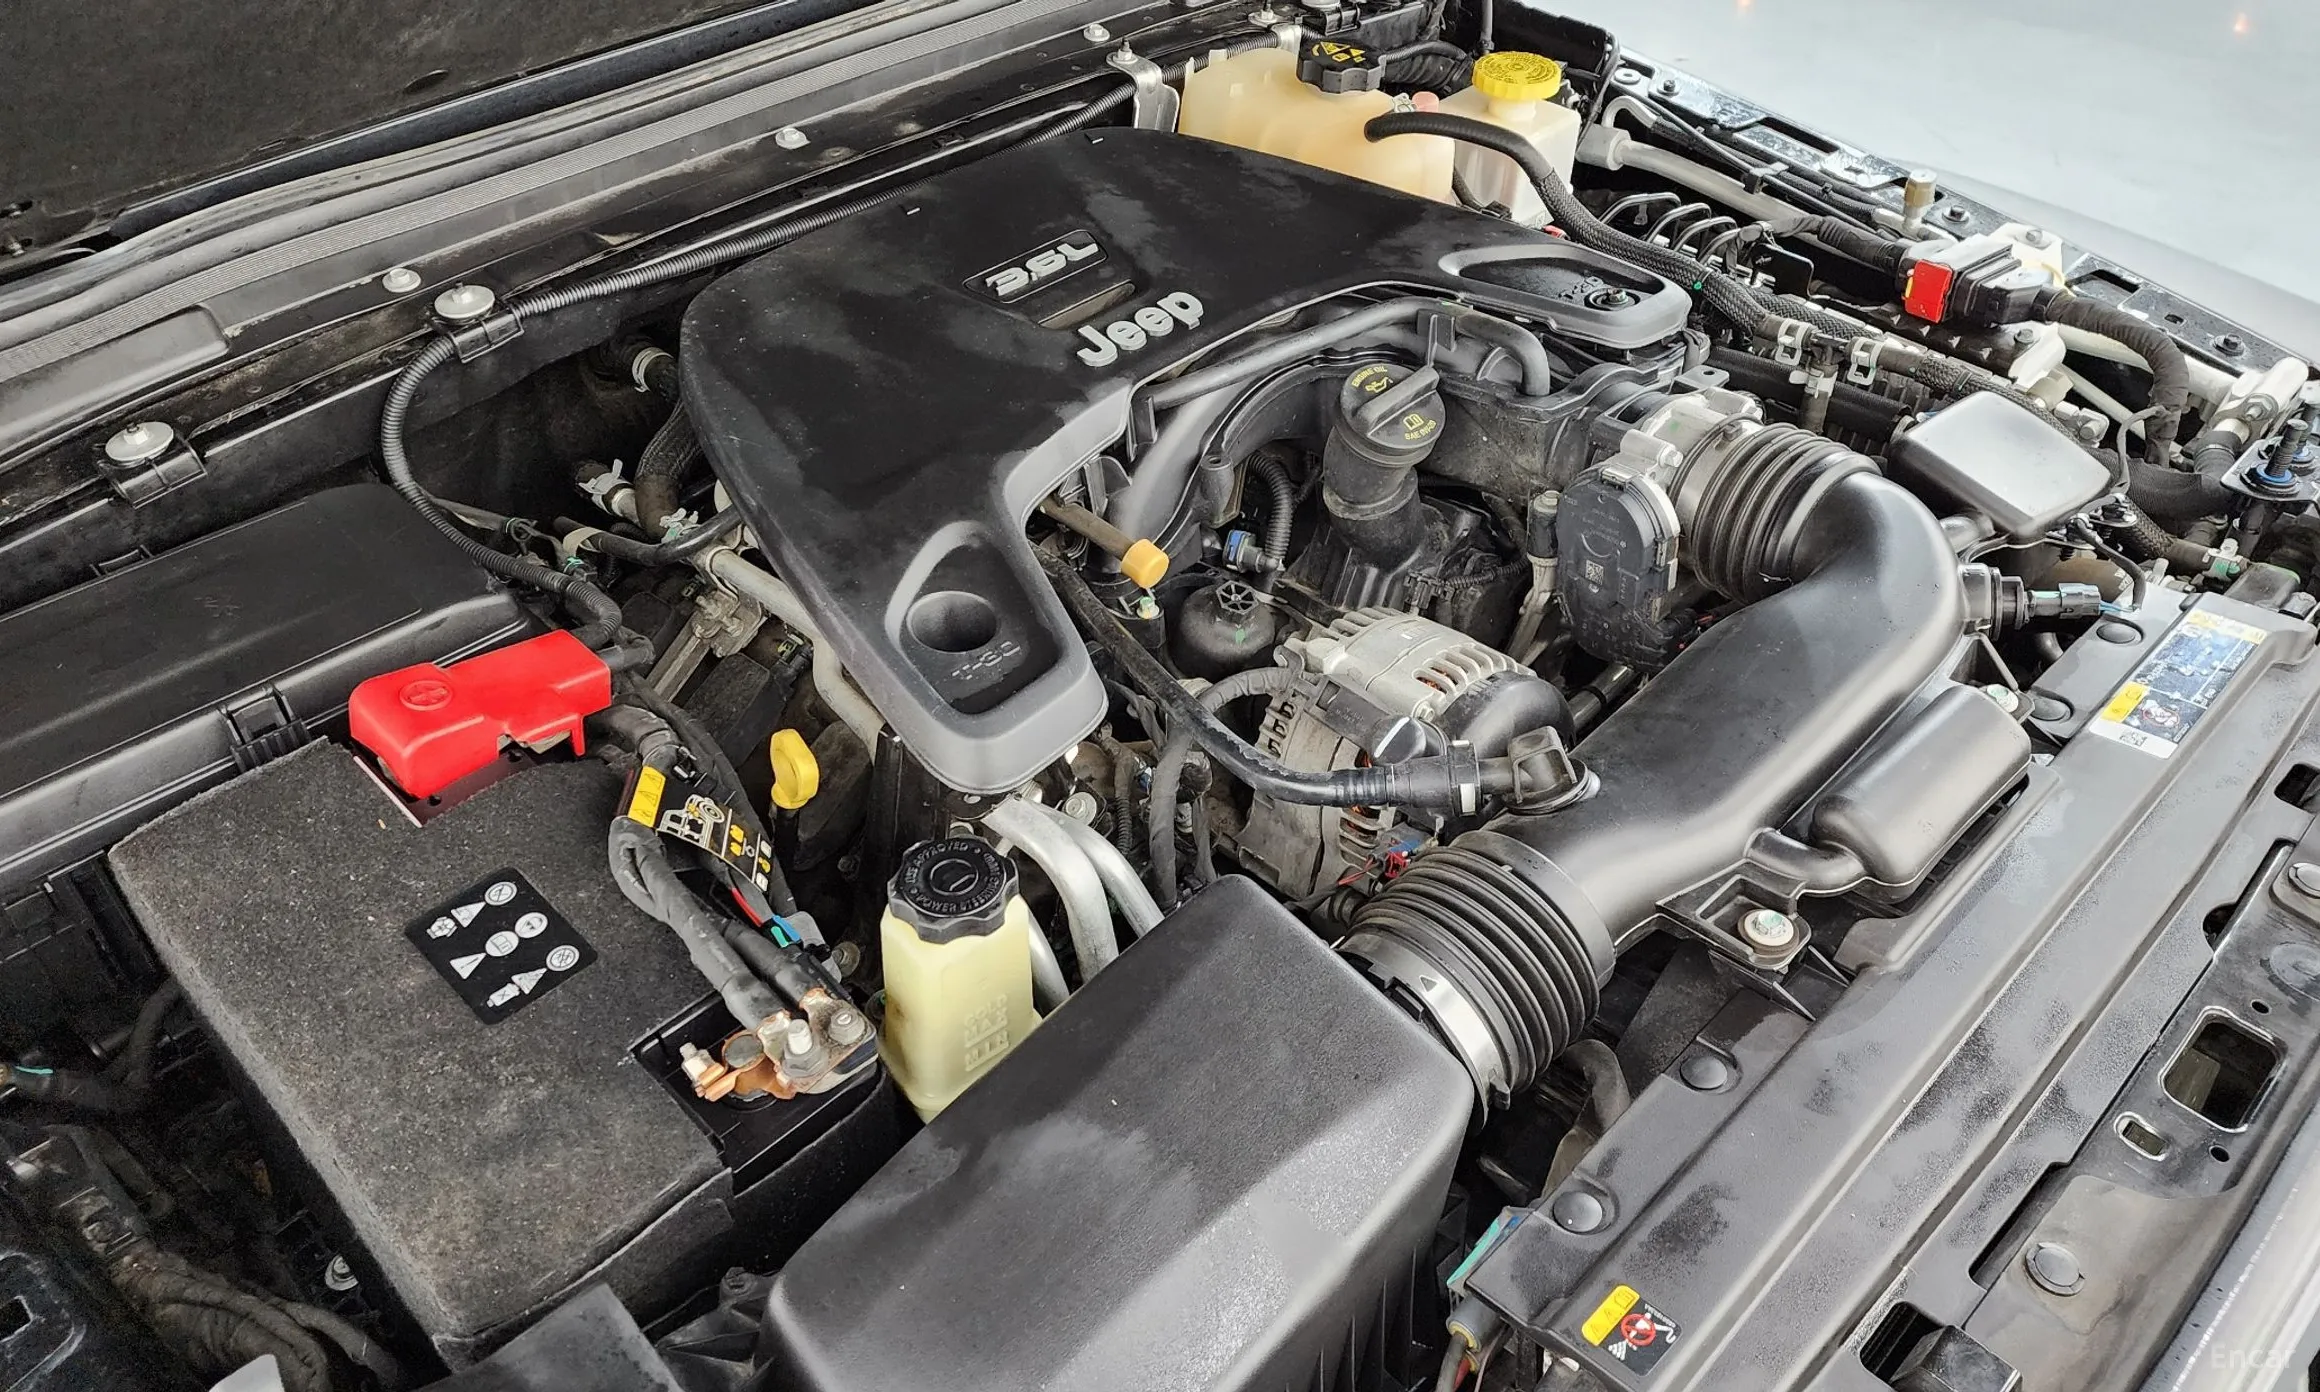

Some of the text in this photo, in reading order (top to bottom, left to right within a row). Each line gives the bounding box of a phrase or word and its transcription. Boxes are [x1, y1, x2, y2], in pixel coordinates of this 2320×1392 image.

[1076, 291, 1204, 367] Jeep
[1351, 367, 1375, 388] ENGINE
[1404, 430, 1421, 440] SAE
[915, 892, 957, 912] POWER
[964, 1029, 1010, 1067] MIN
